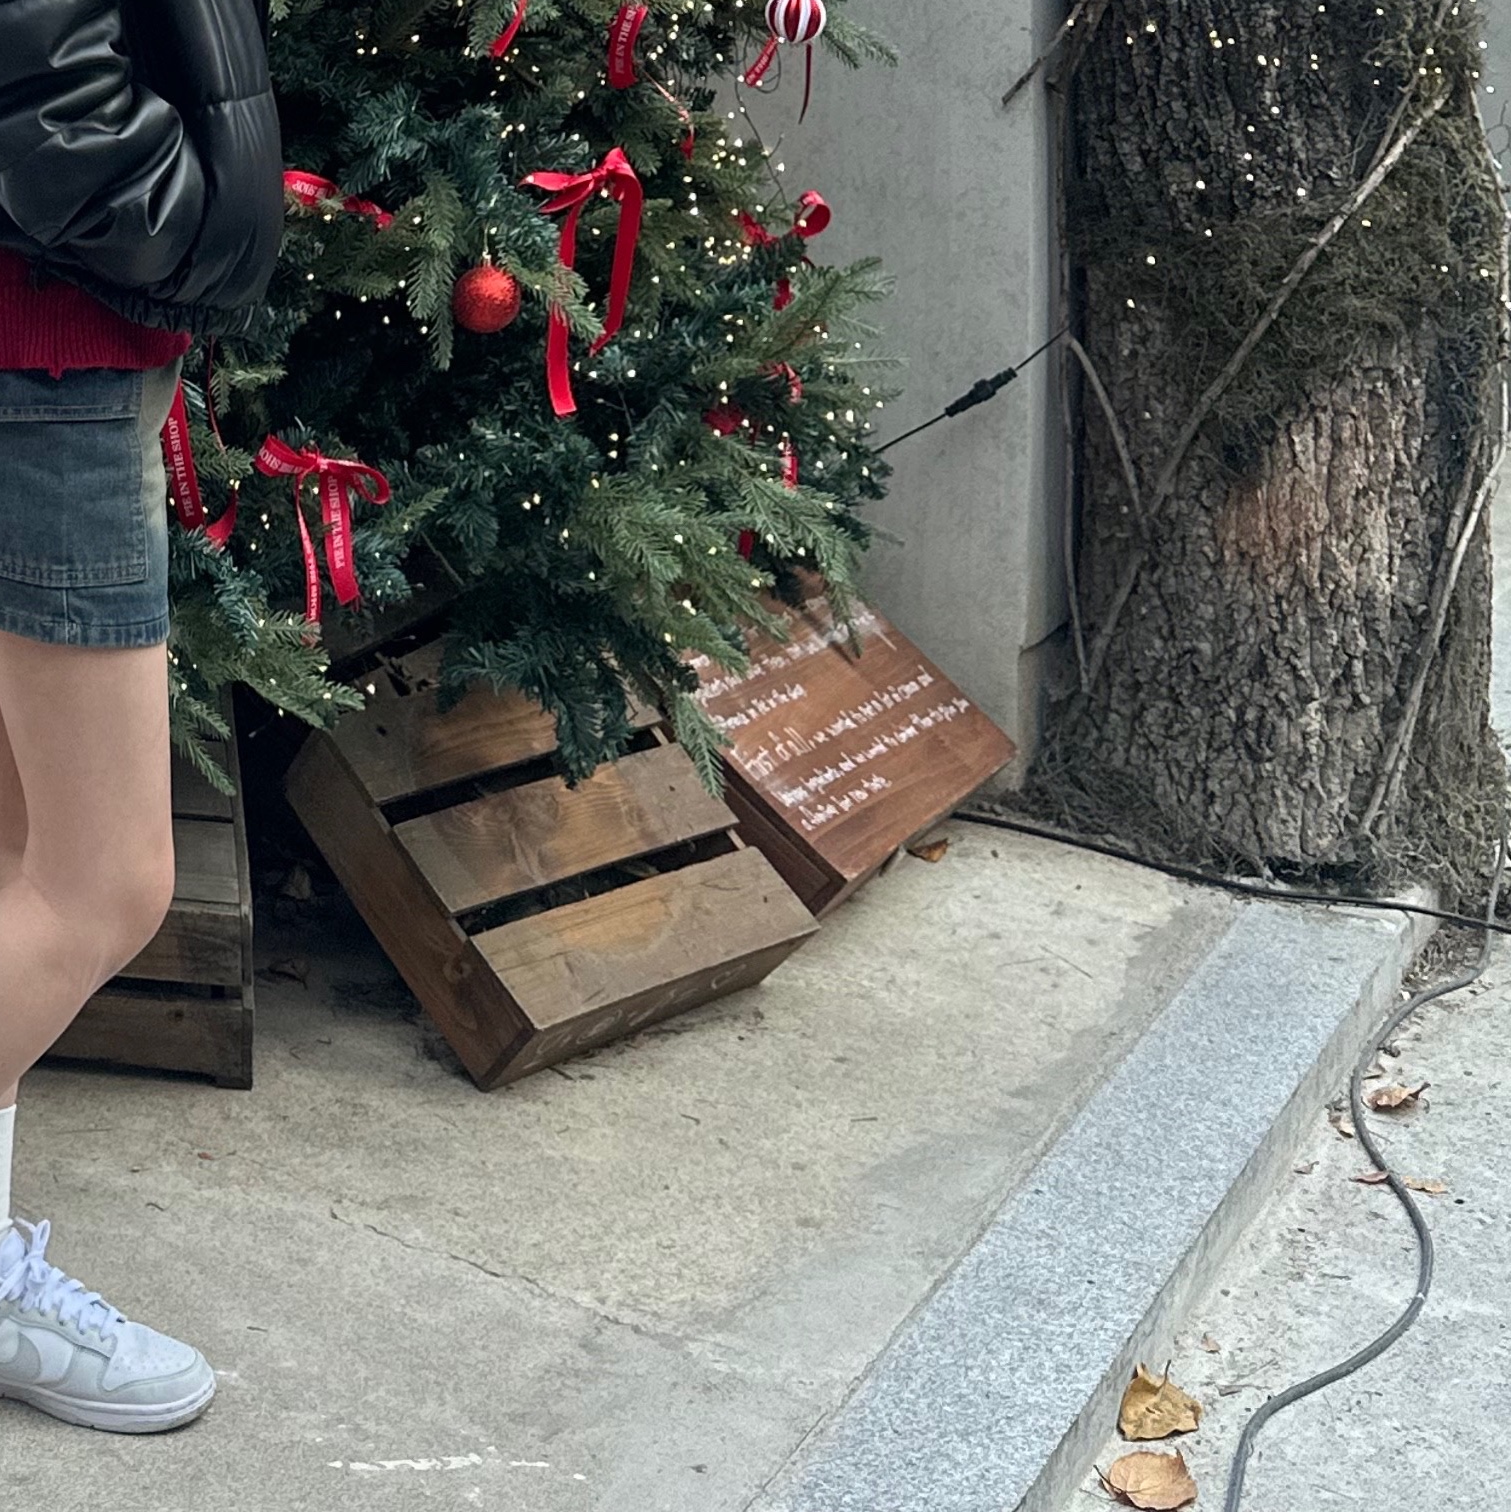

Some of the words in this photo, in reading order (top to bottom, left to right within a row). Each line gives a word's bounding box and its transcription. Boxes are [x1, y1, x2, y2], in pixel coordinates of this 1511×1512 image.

[617, 20, 632, 43] THE
[615, 44, 626, 56] IN
[166, 416, 182, 451] SHOP
[173, 453, 186, 479] THE
[178, 481, 190, 495] IN
[327, 475, 340, 508] SHOP
[182, 496, 194, 516] PIE
[334, 548, 345, 568] PIE
